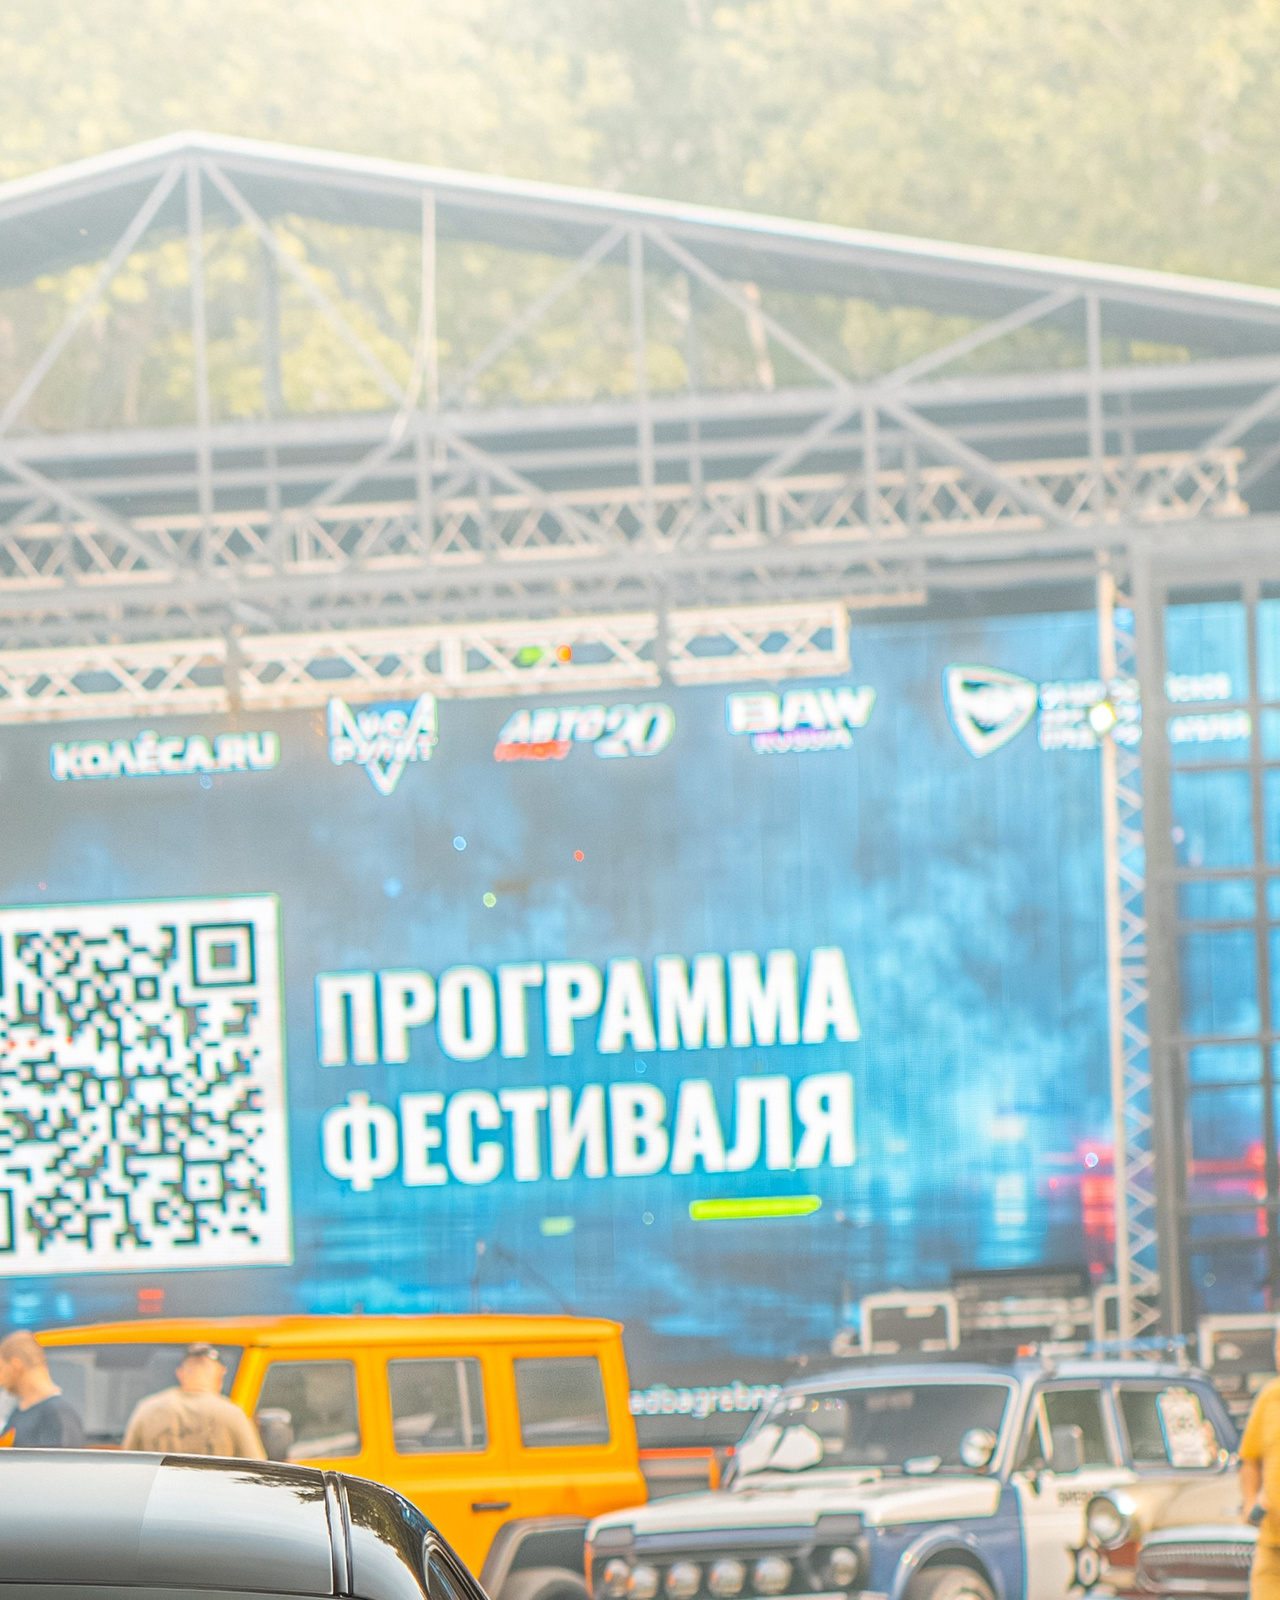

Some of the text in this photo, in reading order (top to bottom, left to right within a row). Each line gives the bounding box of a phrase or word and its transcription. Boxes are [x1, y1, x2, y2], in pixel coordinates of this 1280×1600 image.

[726, 685, 876, 735] BAW
[316, 946, 861, 1068] ПРОГРАММА
[321, 1071, 856, 1192] ФЕСТИВАЛЯ
